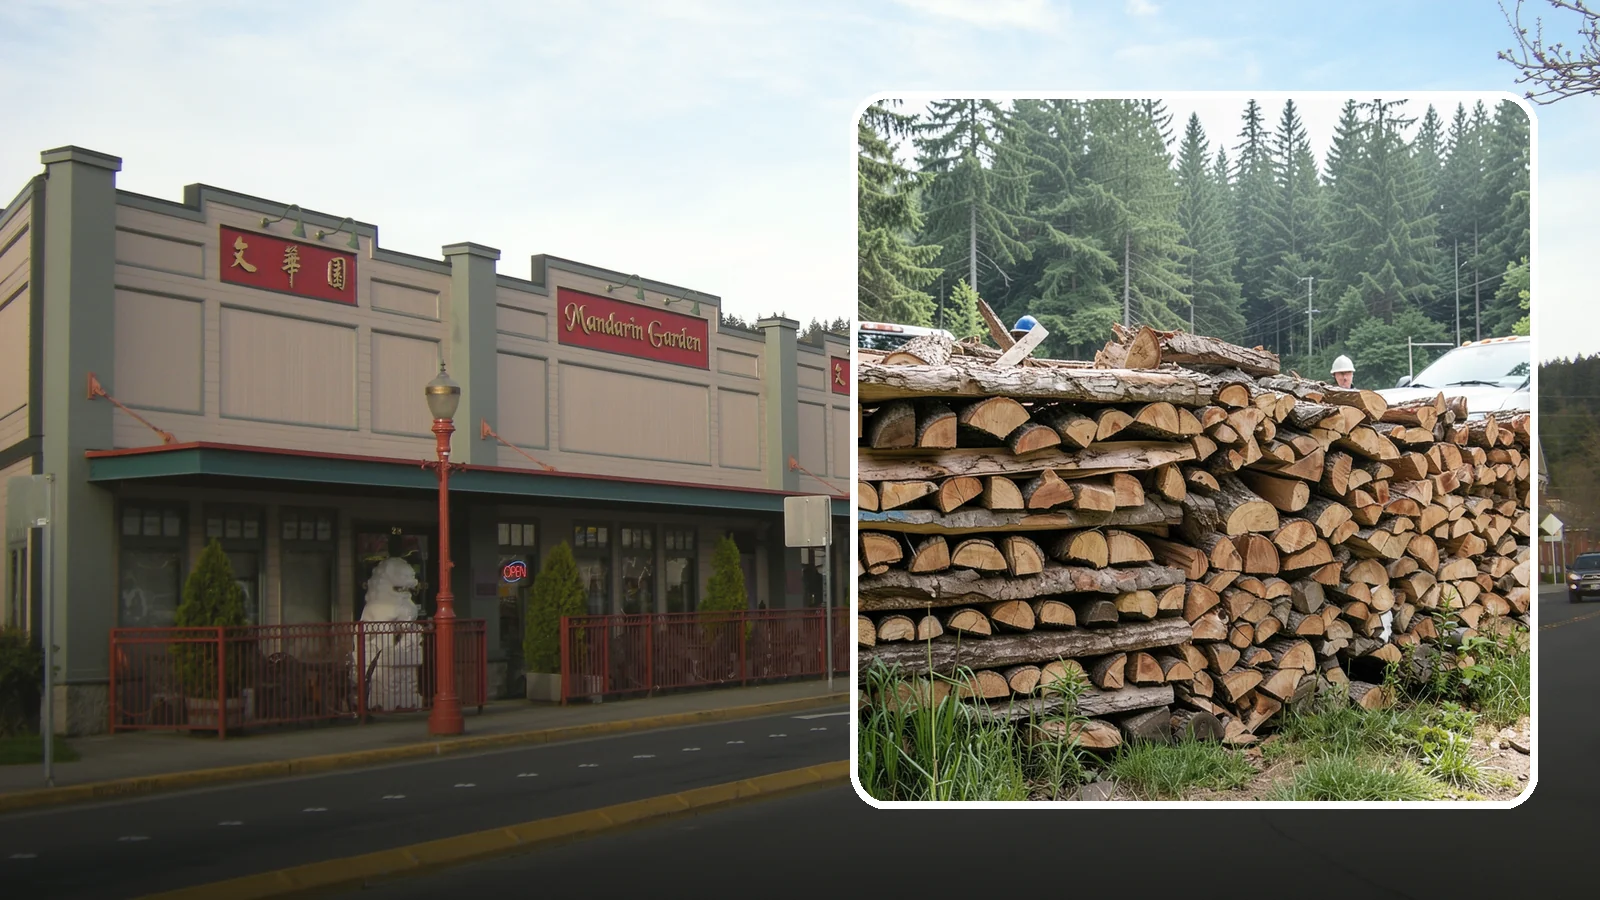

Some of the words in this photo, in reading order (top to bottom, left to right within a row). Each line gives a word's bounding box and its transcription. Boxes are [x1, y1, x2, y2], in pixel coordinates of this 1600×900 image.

[231, 236, 346, 290] 文華園
[564, 302, 643, 341] Mandarin
[648, 320, 701, 352] Garden
[503, 565, 526, 578] OPEN
